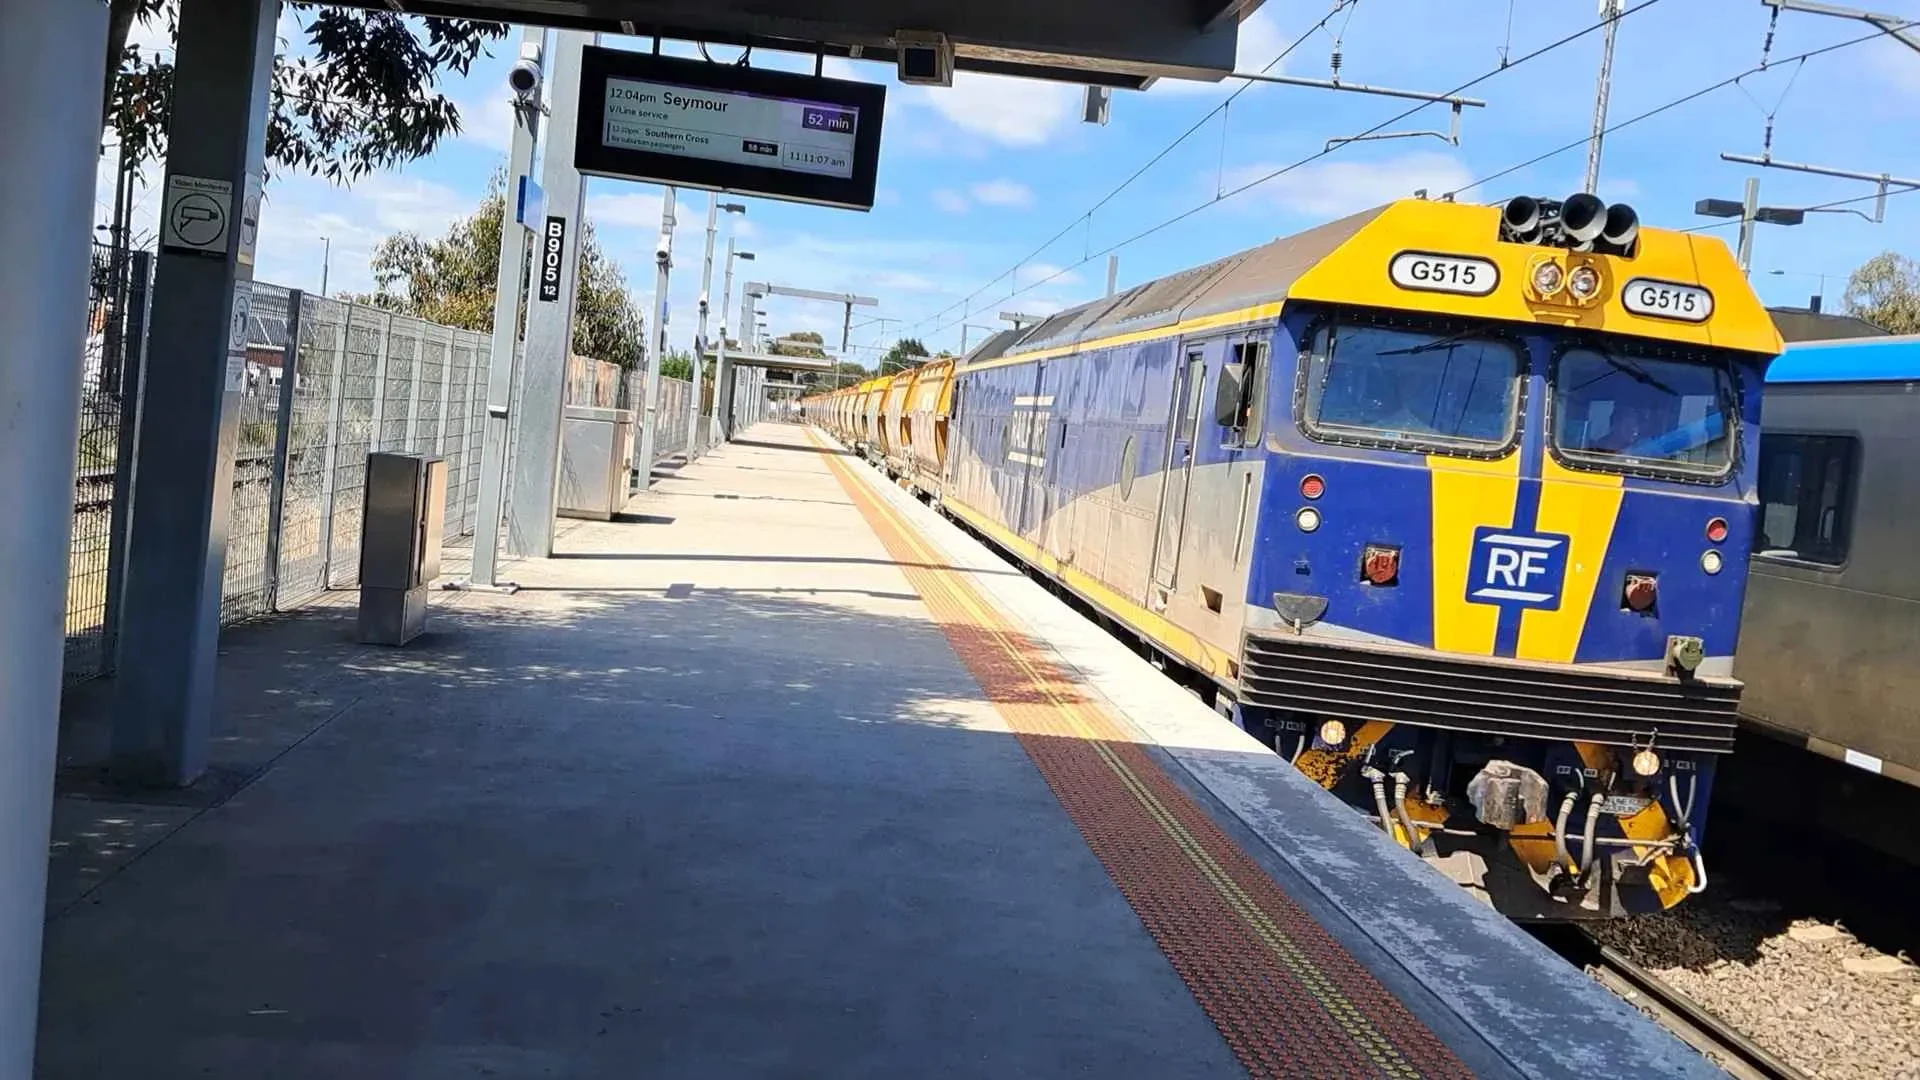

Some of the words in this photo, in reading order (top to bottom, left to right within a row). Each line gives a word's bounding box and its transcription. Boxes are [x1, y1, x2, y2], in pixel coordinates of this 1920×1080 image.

[663, 92, 728, 112] Seymour
[609, 105, 636, 116] V/Line
[638, 110, 669, 120] service
[808, 114, 823, 126] 52
[828, 117, 849, 130] min
[645, 128, 684, 141] Southern
[685, 133, 709, 145] Cross
[831, 158, 846, 168] am
[545, 222, 562, 281] B905
[1411, 260, 1477, 285] G515
[544, 285, 556, 296] 12
[1640, 287, 1696, 312] G515
[1486, 547, 1549, 587] RF
